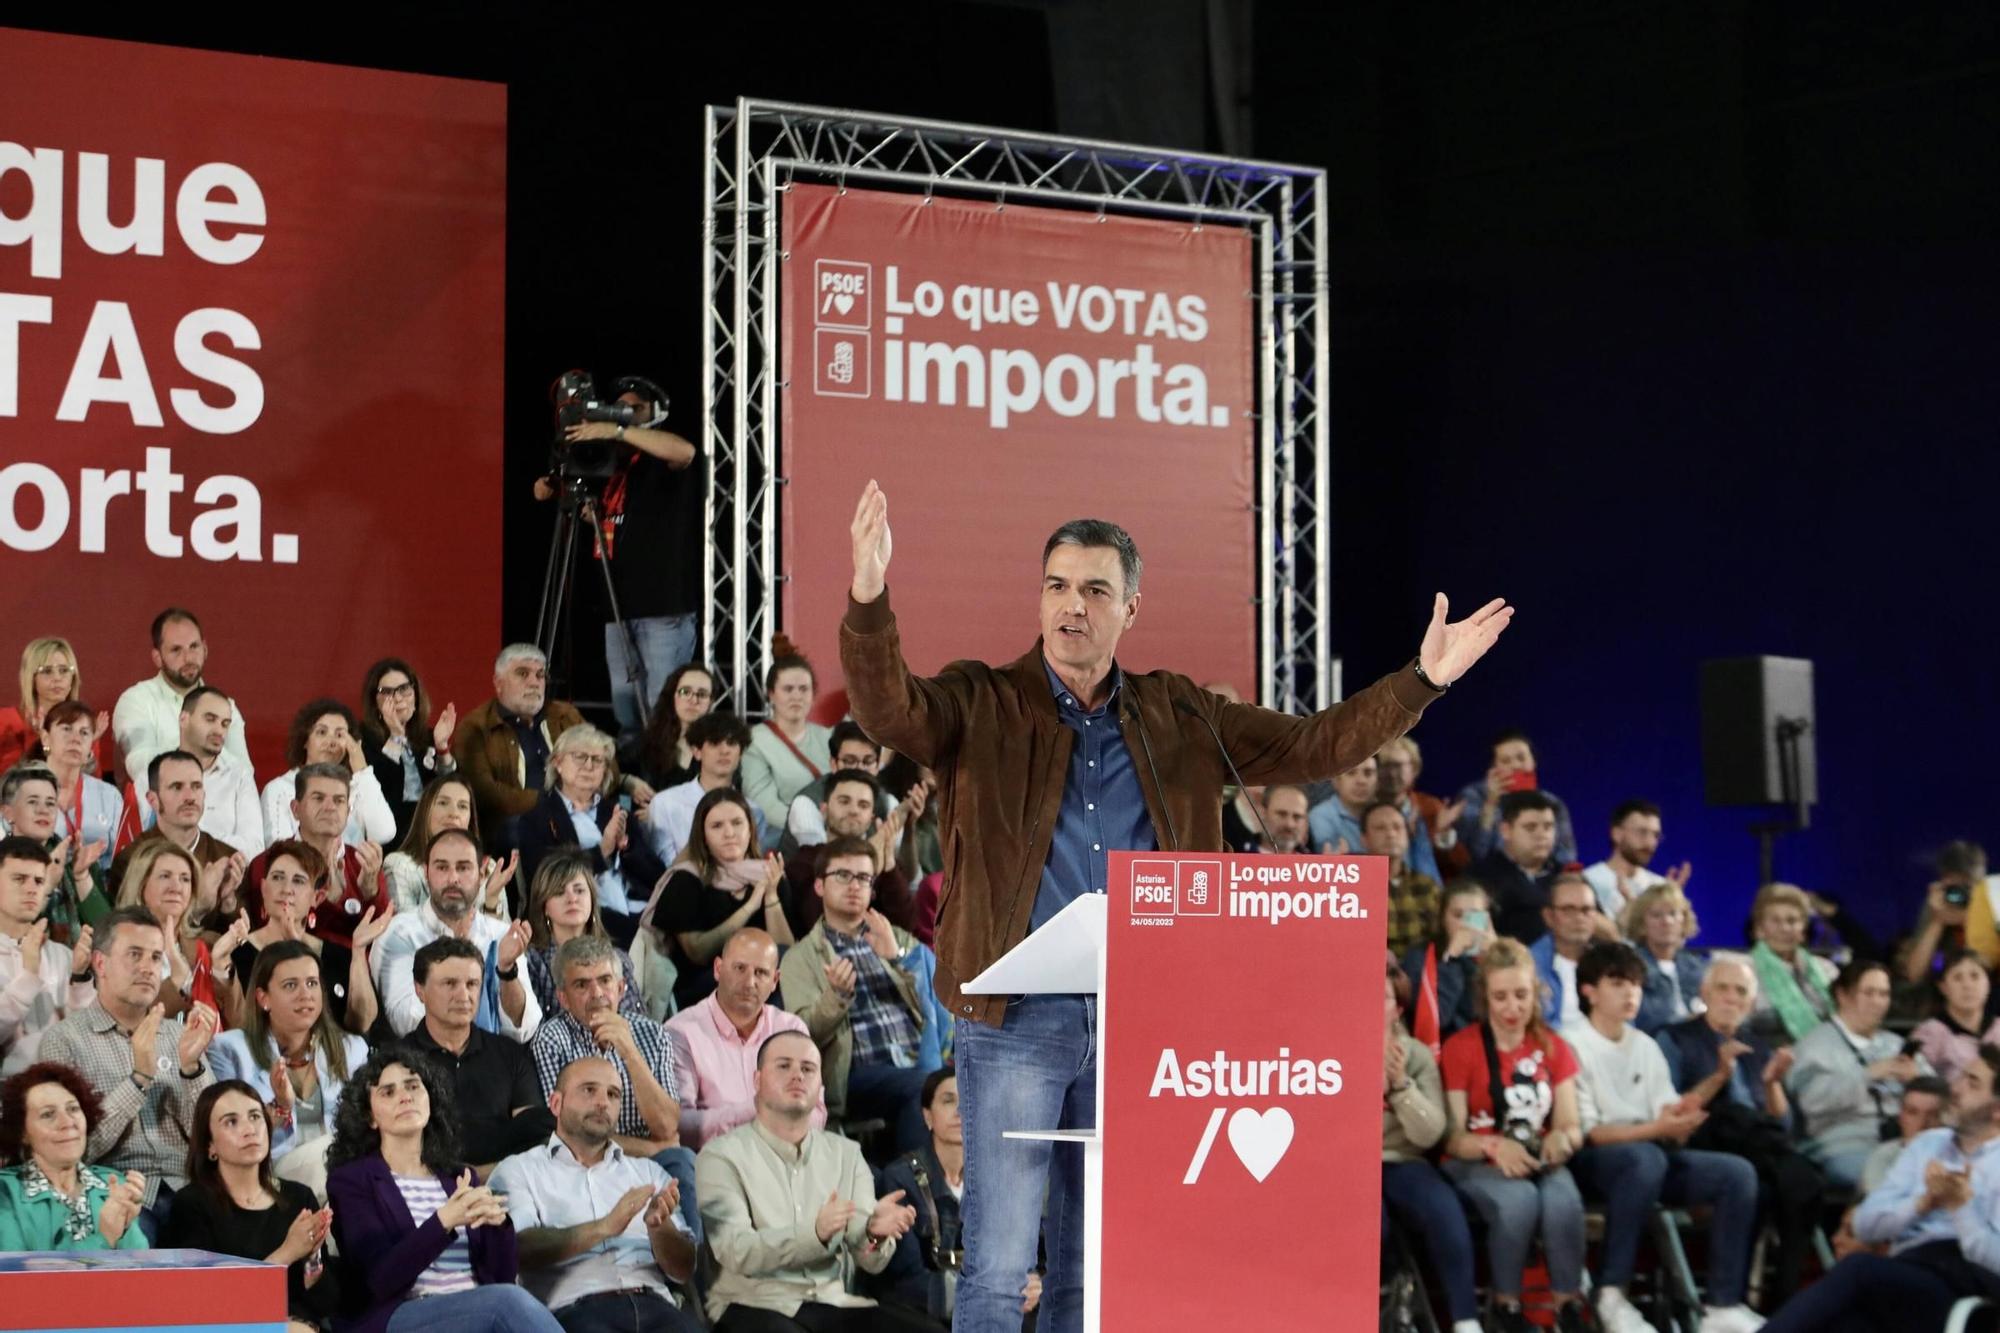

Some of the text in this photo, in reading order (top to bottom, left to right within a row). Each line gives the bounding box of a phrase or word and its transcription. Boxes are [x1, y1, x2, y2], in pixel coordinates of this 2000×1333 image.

[821, 271, 865, 295] PSOE
[885, 265, 1209, 342] Lo que VOTAS
[884, 316, 1230, 429] importa.
[1135, 874, 1166, 885] Asturias
[1230, 861, 1360, 886] Lo que VOTAS
[1134, 885, 1174, 903] PSOE
[1230, 881, 1368, 925] importa.
[1131, 918, 1174, 926] 24/05/2023
[1148, 1047, 1343, 1098] Asturias
